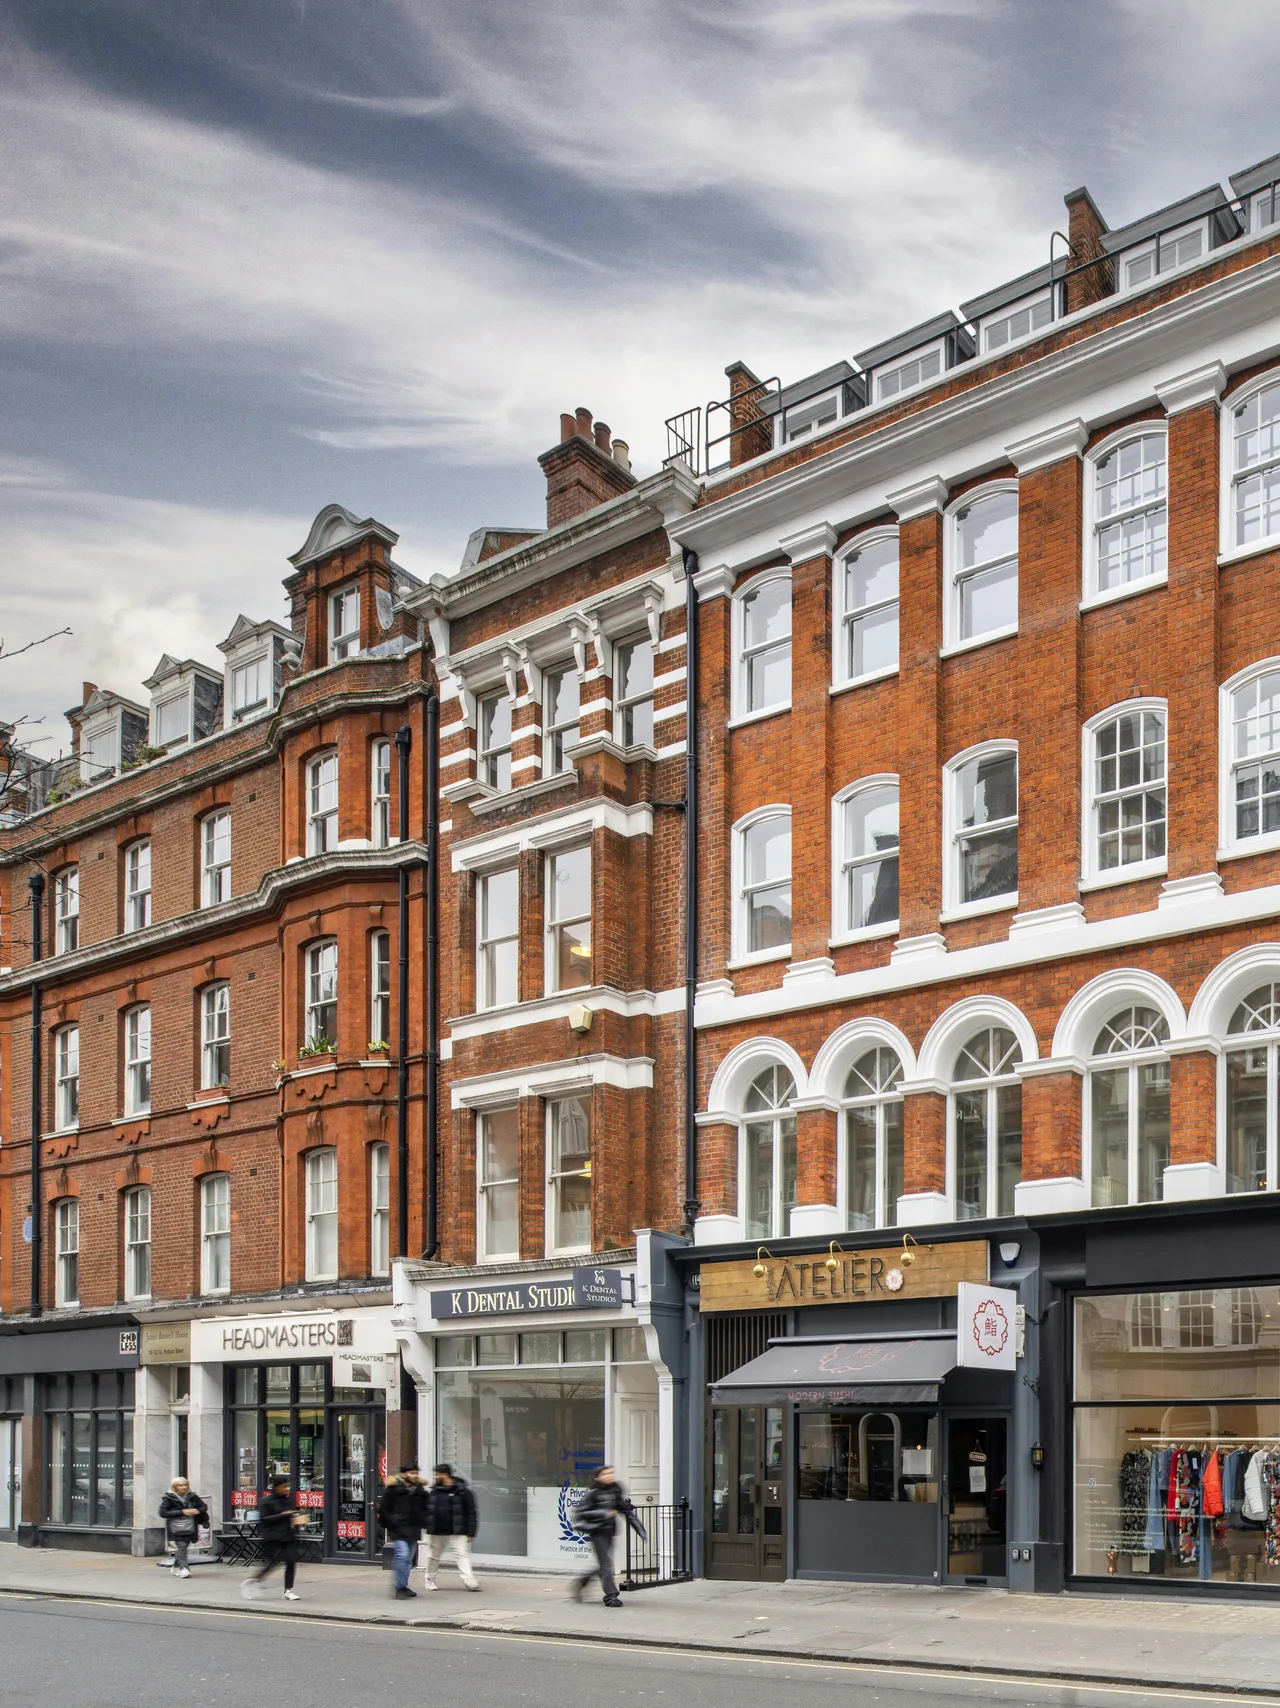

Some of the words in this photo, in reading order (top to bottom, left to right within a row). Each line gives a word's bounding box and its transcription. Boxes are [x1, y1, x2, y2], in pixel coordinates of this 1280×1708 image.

[775, 1257, 884, 1299] ATELIER
[590, 1285, 618, 1294] DENTAL
[451, 1292, 463, 1315] K
[467, 1291, 525, 1313] DENTAL
[528, 1285, 575, 1309] STUDI
[587, 1294, 617, 1303] STUDIOS
[121, 1332, 137, 1343] END
[145, 1332, 157, 1343] James
[175, 1330, 188, 1339] House
[222, 1322, 336, 1350] HEADMASTERS
[120, 1342, 137, 1352] LESS
[339, 1354, 384, 1362] HEADMASTERS
[788, 1391, 825, 1400] MODERN
[828, 1390, 854, 1399] SUSHI
[970, 1453, 986, 1461] CLOSED
[347, 1529, 363, 1537] SALE
[560, 1545, 578, 1553] Practice
